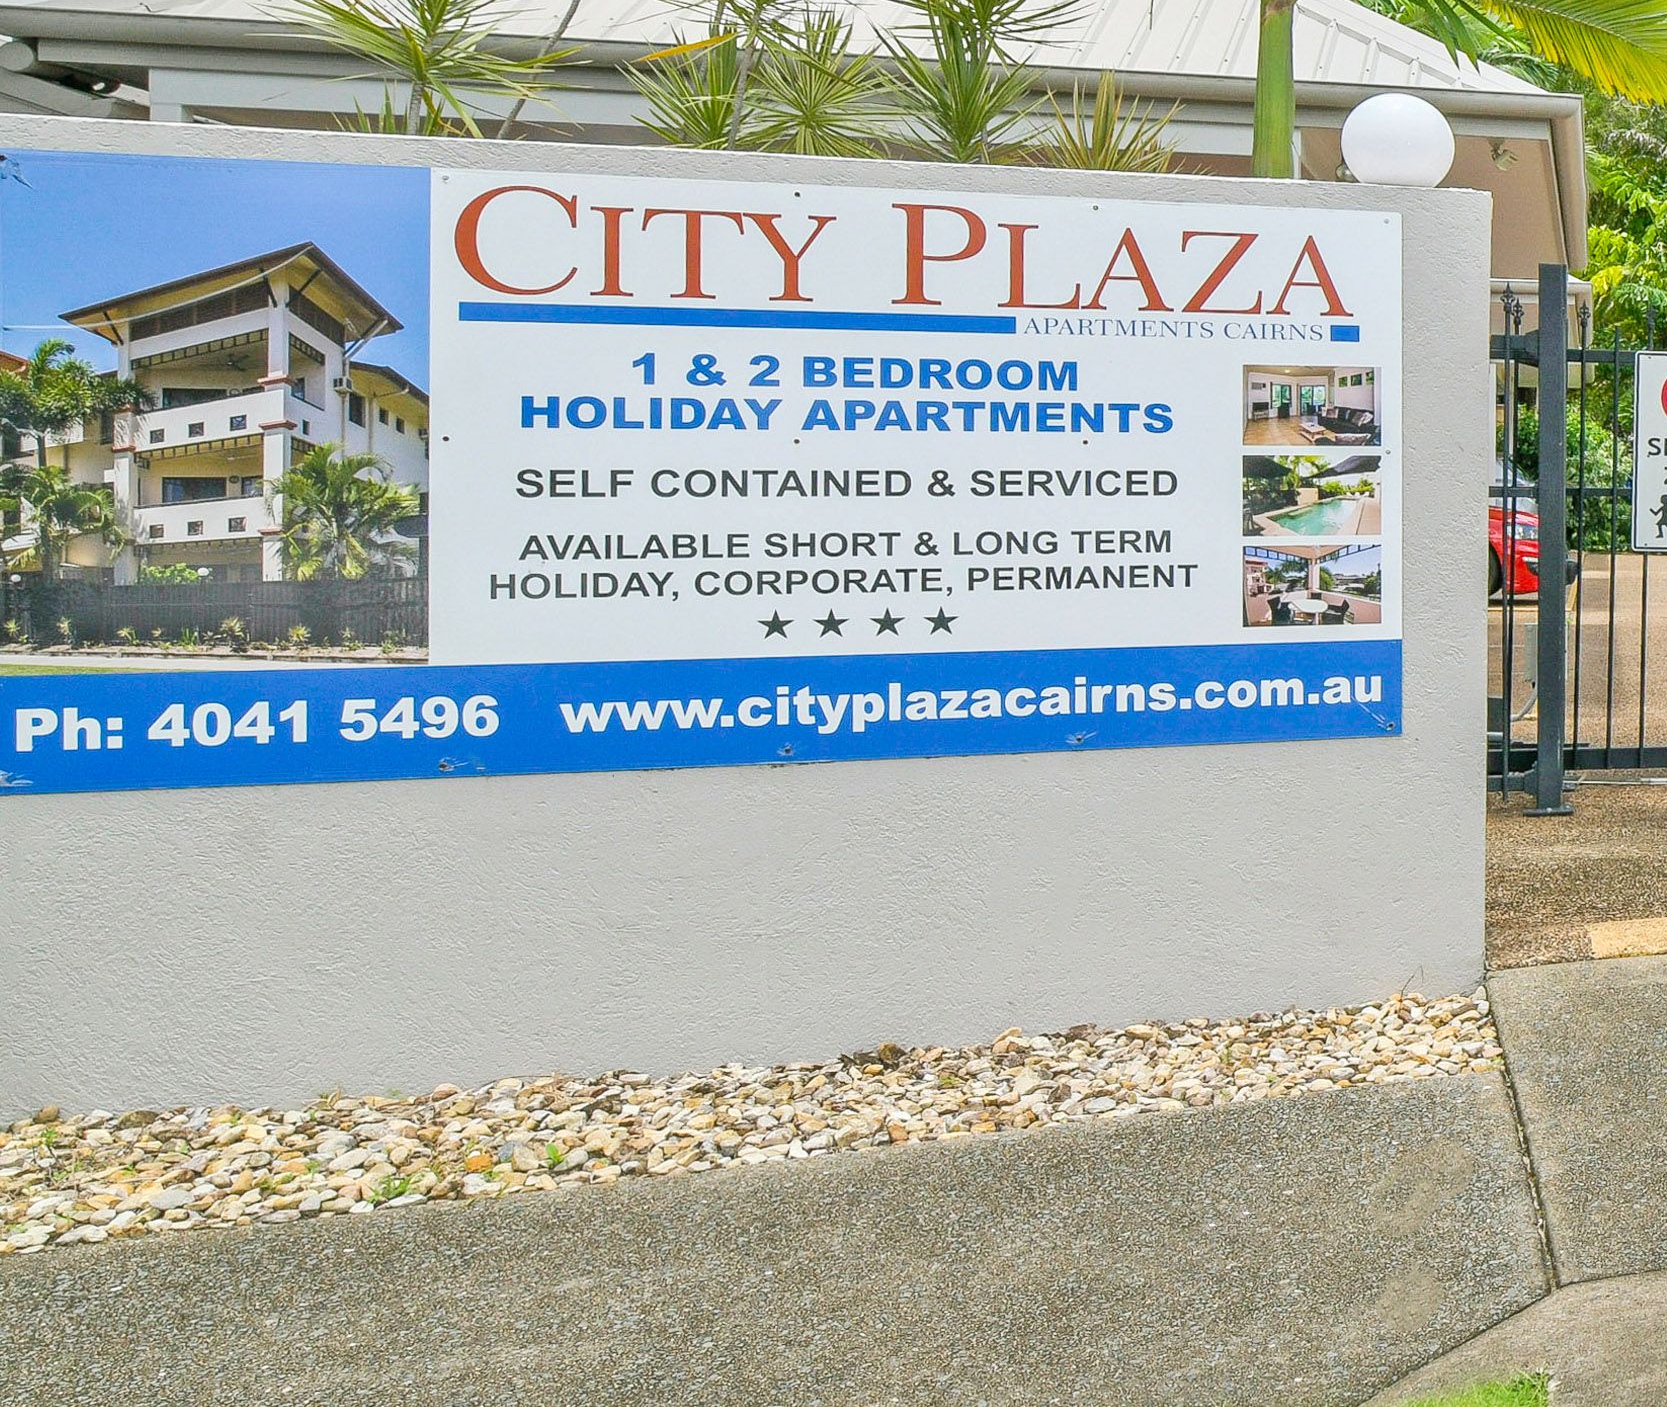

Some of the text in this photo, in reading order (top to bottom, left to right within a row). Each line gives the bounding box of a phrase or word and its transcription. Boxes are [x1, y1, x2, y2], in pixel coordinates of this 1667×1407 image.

[453, 185, 1354, 318] CITY PLAZA
[1023, 317, 1324, 343] APARTMENTS CAIRNS
[632, 352, 1079, 392] 1 & 2 BEDROOM
[520, 395, 1174, 436] HOLIDAY APARTMENTS
[515, 469, 1179, 498] SELF CONTAINED & SERVICED
[518, 529, 1172, 561] AVAILABLE SHORT & LONG TERM
[489, 563, 1199, 602] HOLIDAY, CORPORATE, PERMANENT
[15, 694, 500, 753] Ph: 4041 5496
[559, 674, 1384, 735] www.cityplazacairns.com.au
